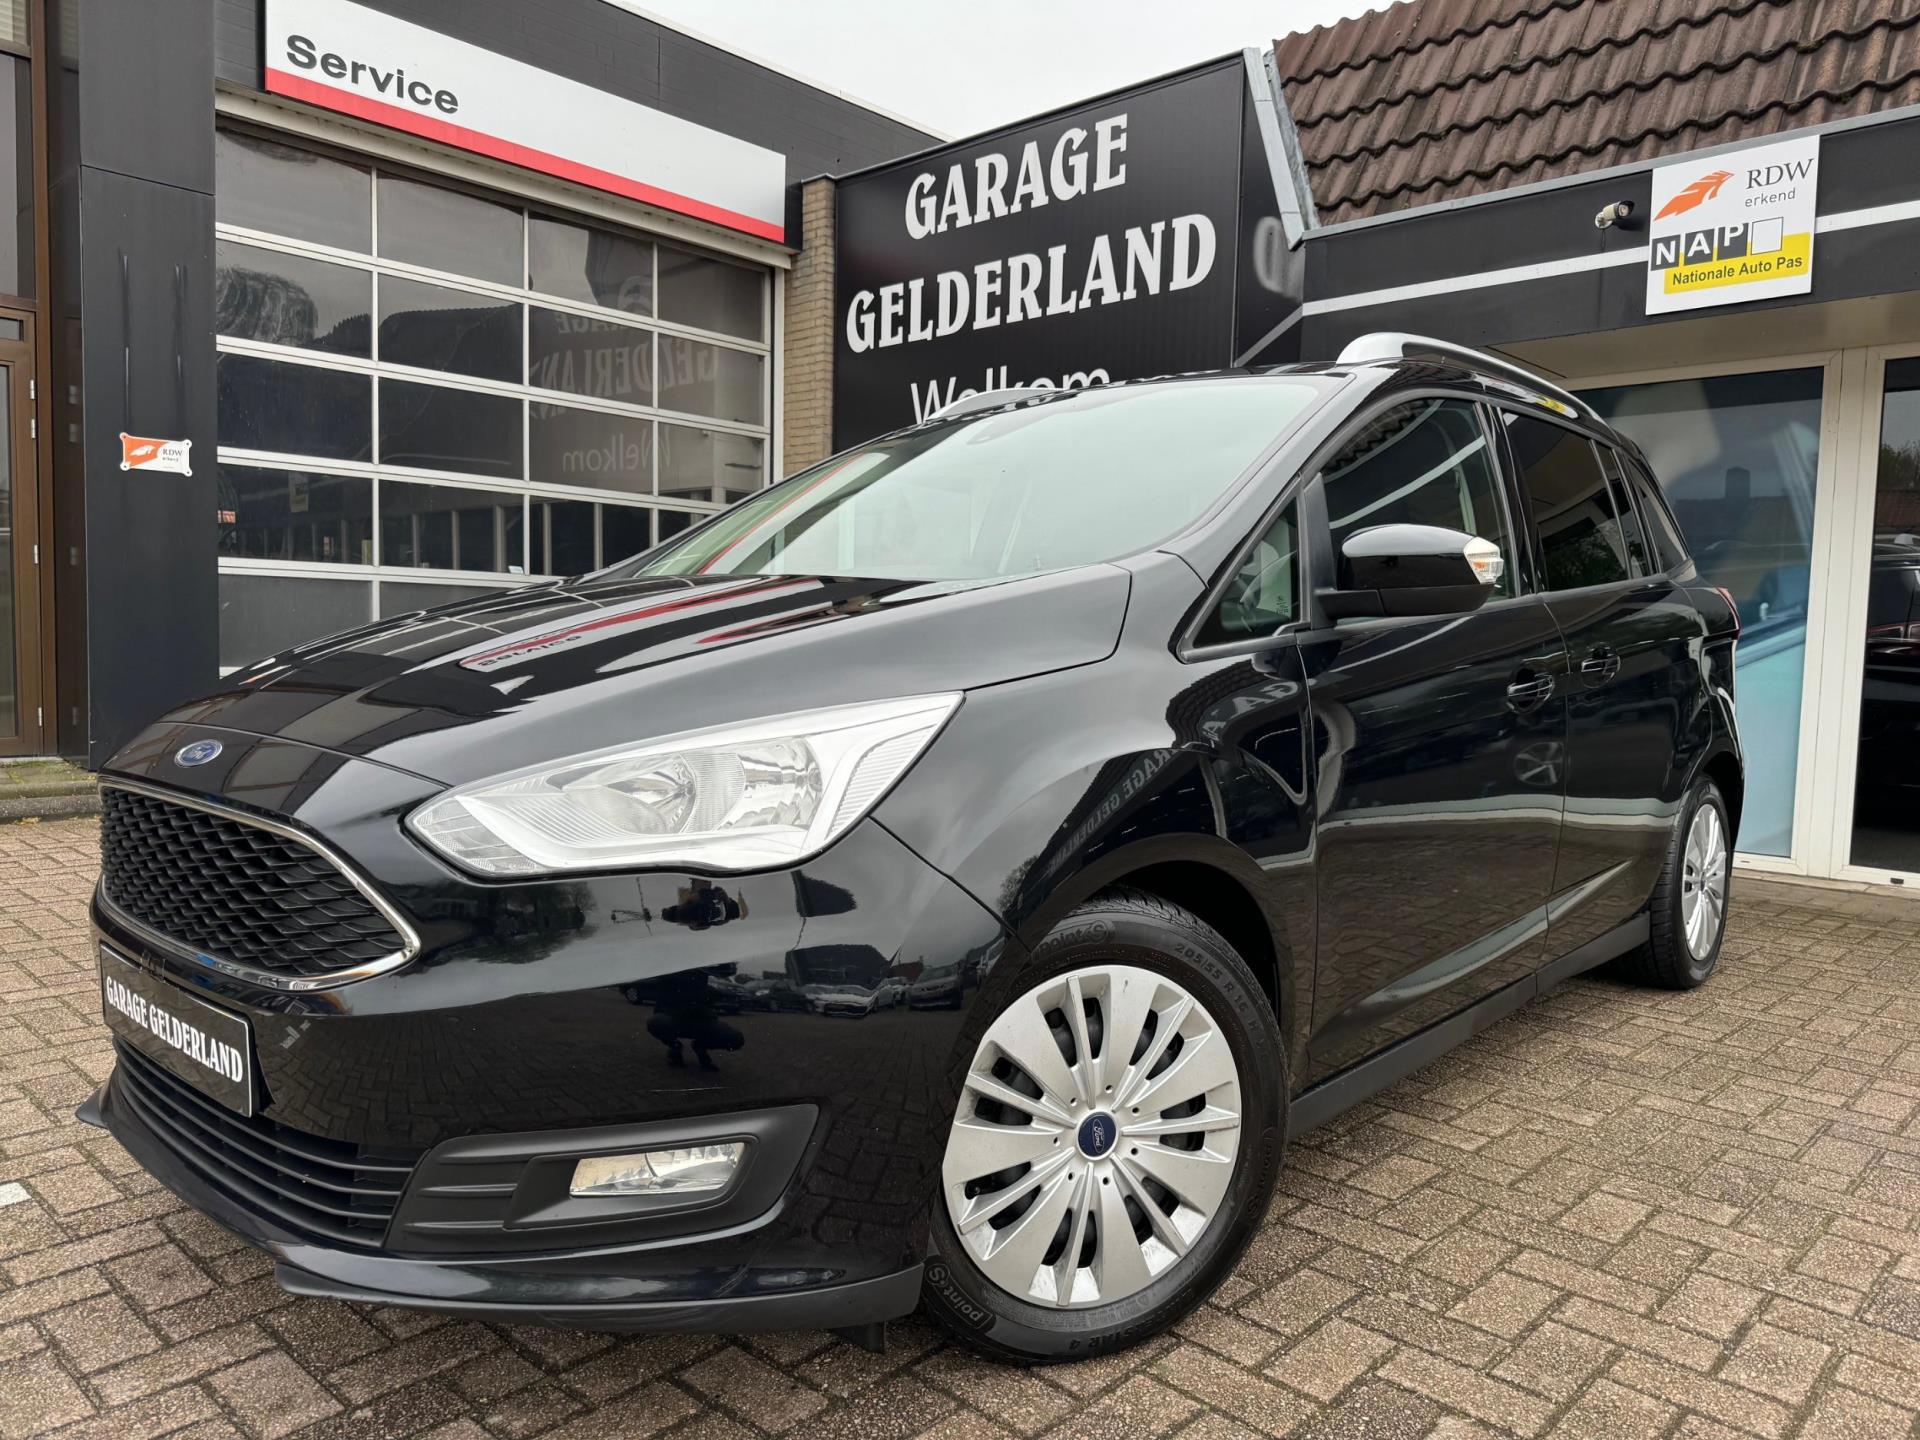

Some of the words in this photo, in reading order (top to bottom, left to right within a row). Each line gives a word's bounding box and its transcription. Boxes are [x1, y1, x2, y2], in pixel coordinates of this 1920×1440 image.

[286, 33, 459, 114] Service
[905, 113, 1128, 240] GARAGE
[1746, 158, 1814, 189] RDW
[1745, 187, 1796, 208] erkend
[1655, 223, 1744, 265] NAP
[846, 213, 1217, 354] GELDERLAND
[1672, 265, 1735, 286] Nationale
[1738, 258, 1772, 276] Auto
[1776, 256, 1803, 270] Pas
[161, 448, 183, 457] RDW
[106, 976, 148, 1029] GARAGE
[150, 1003, 243, 1083] GELDERLAND
